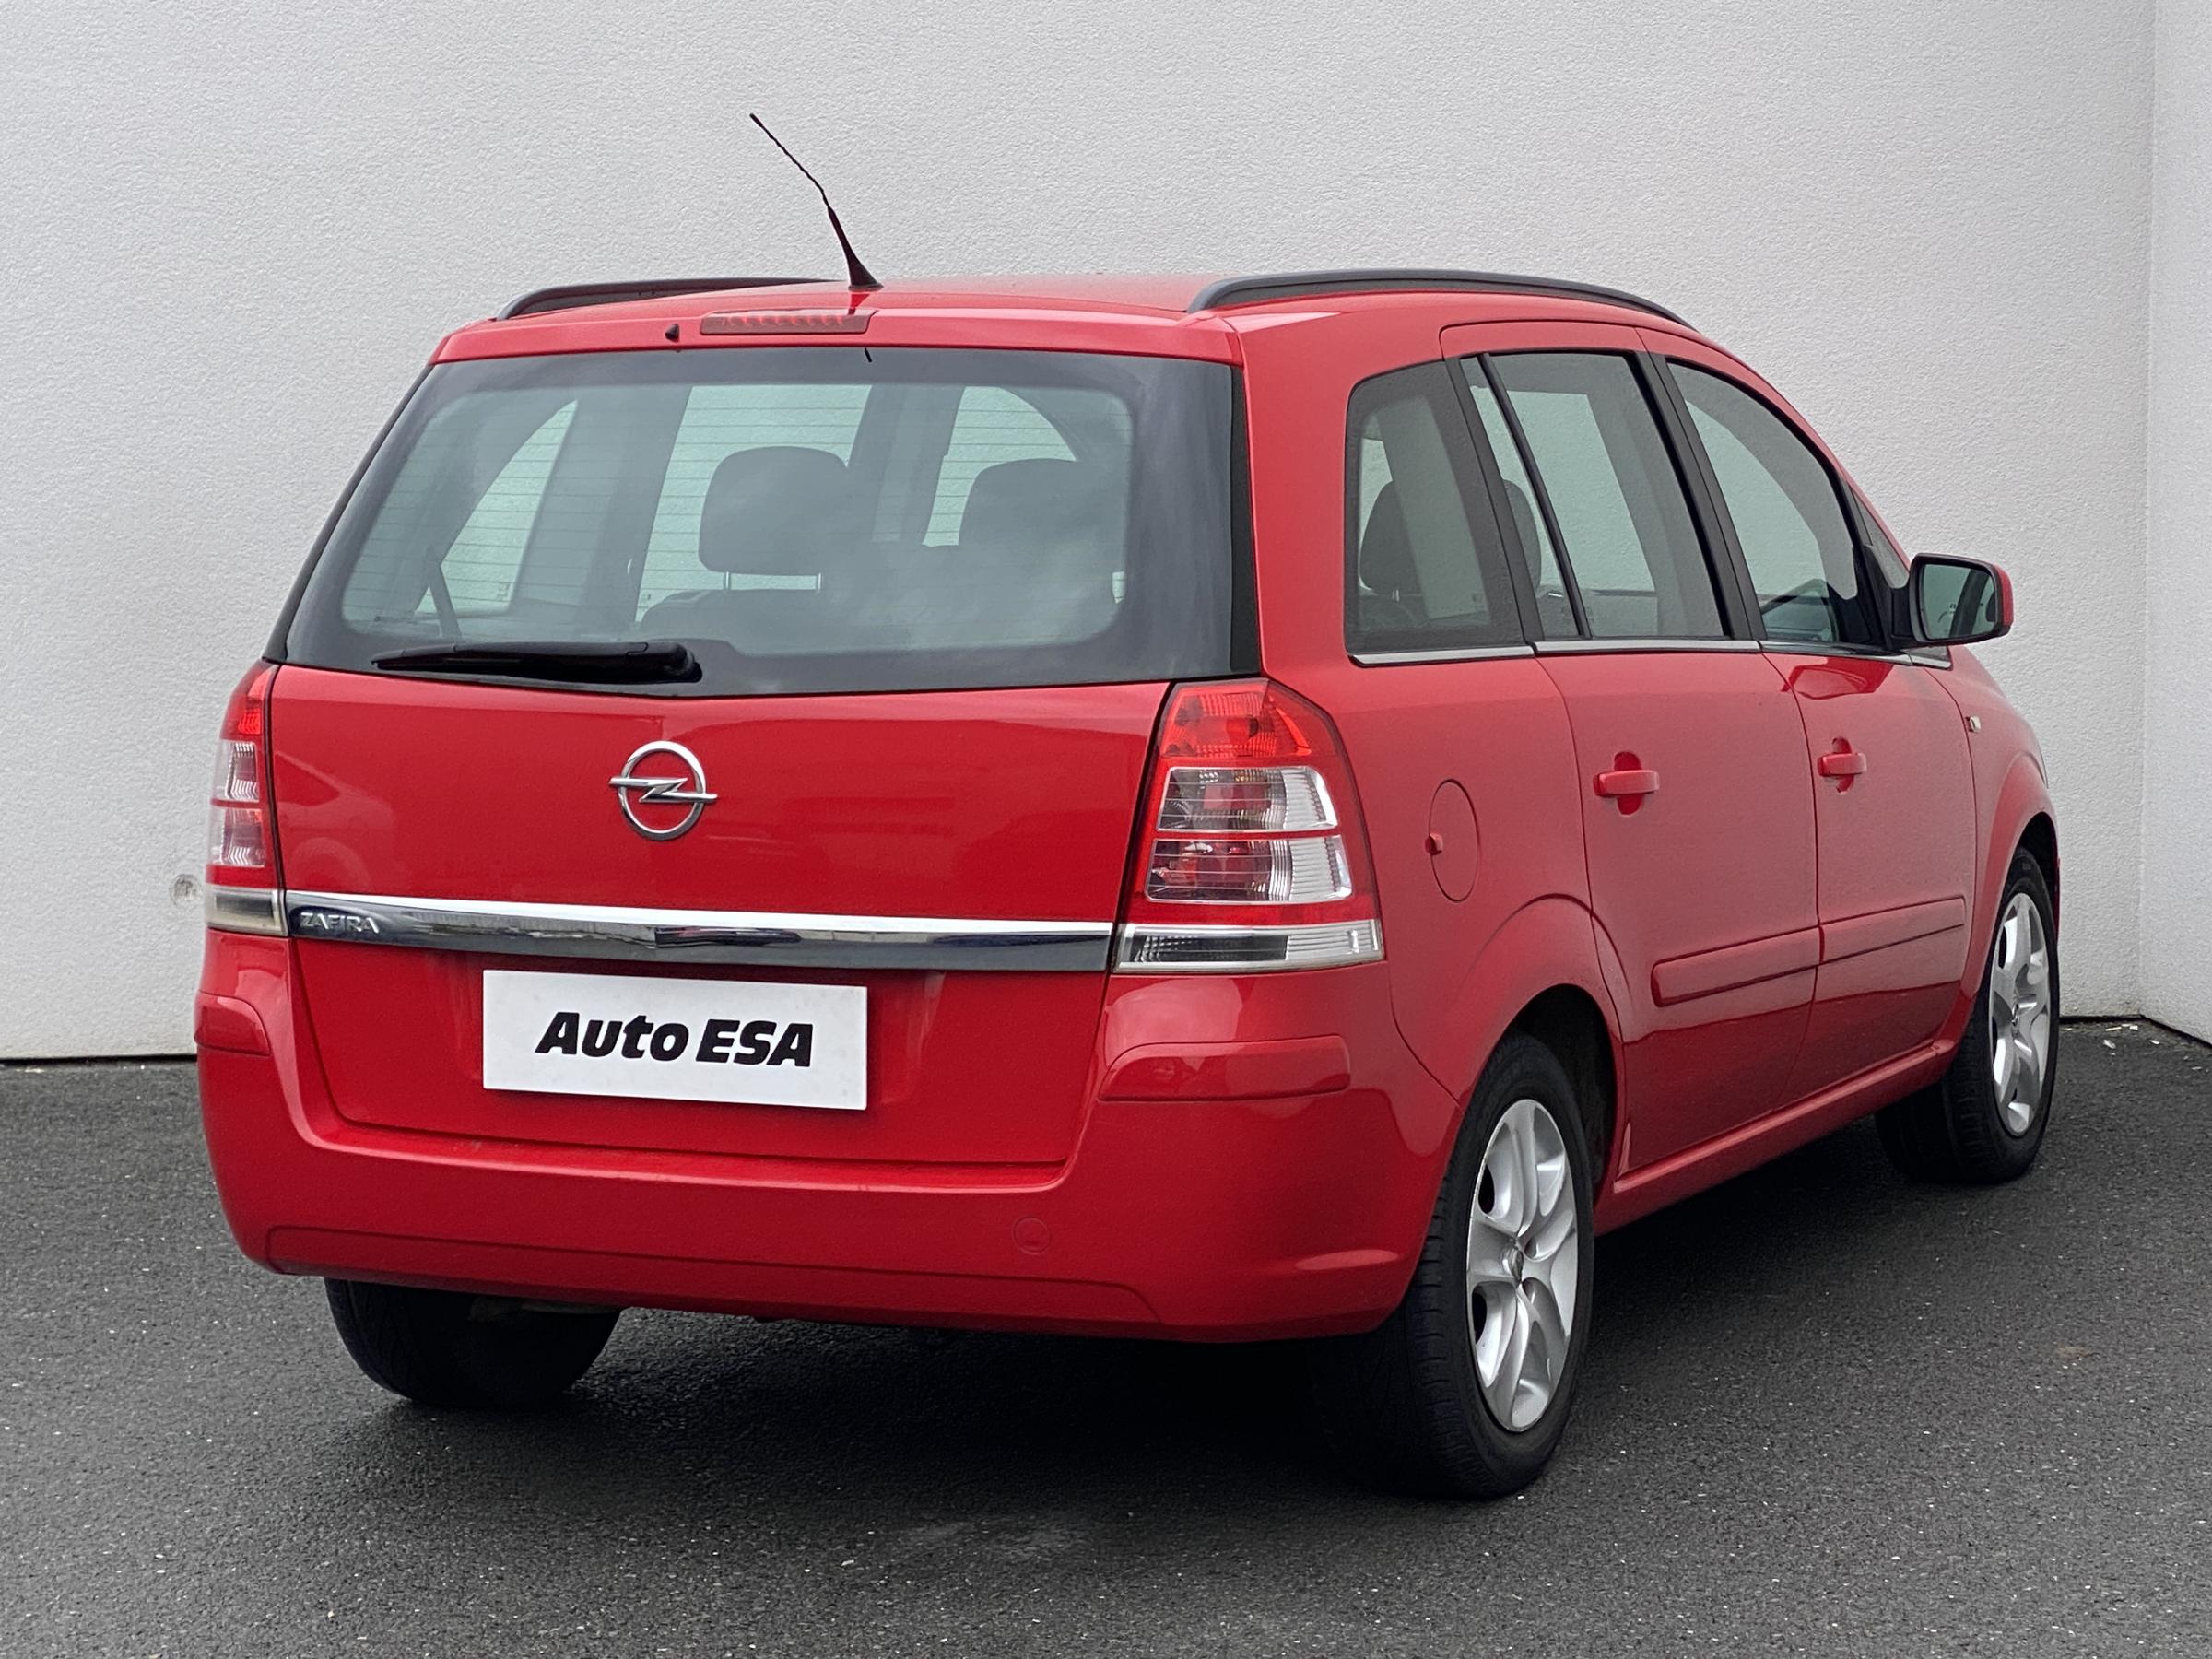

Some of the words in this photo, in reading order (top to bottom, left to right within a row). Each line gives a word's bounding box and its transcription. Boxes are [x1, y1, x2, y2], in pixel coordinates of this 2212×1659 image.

[300, 912, 380, 934] ZAFIRA
[535, 1011, 689, 1062] Auto
[696, 1018, 813, 1067] ESA
